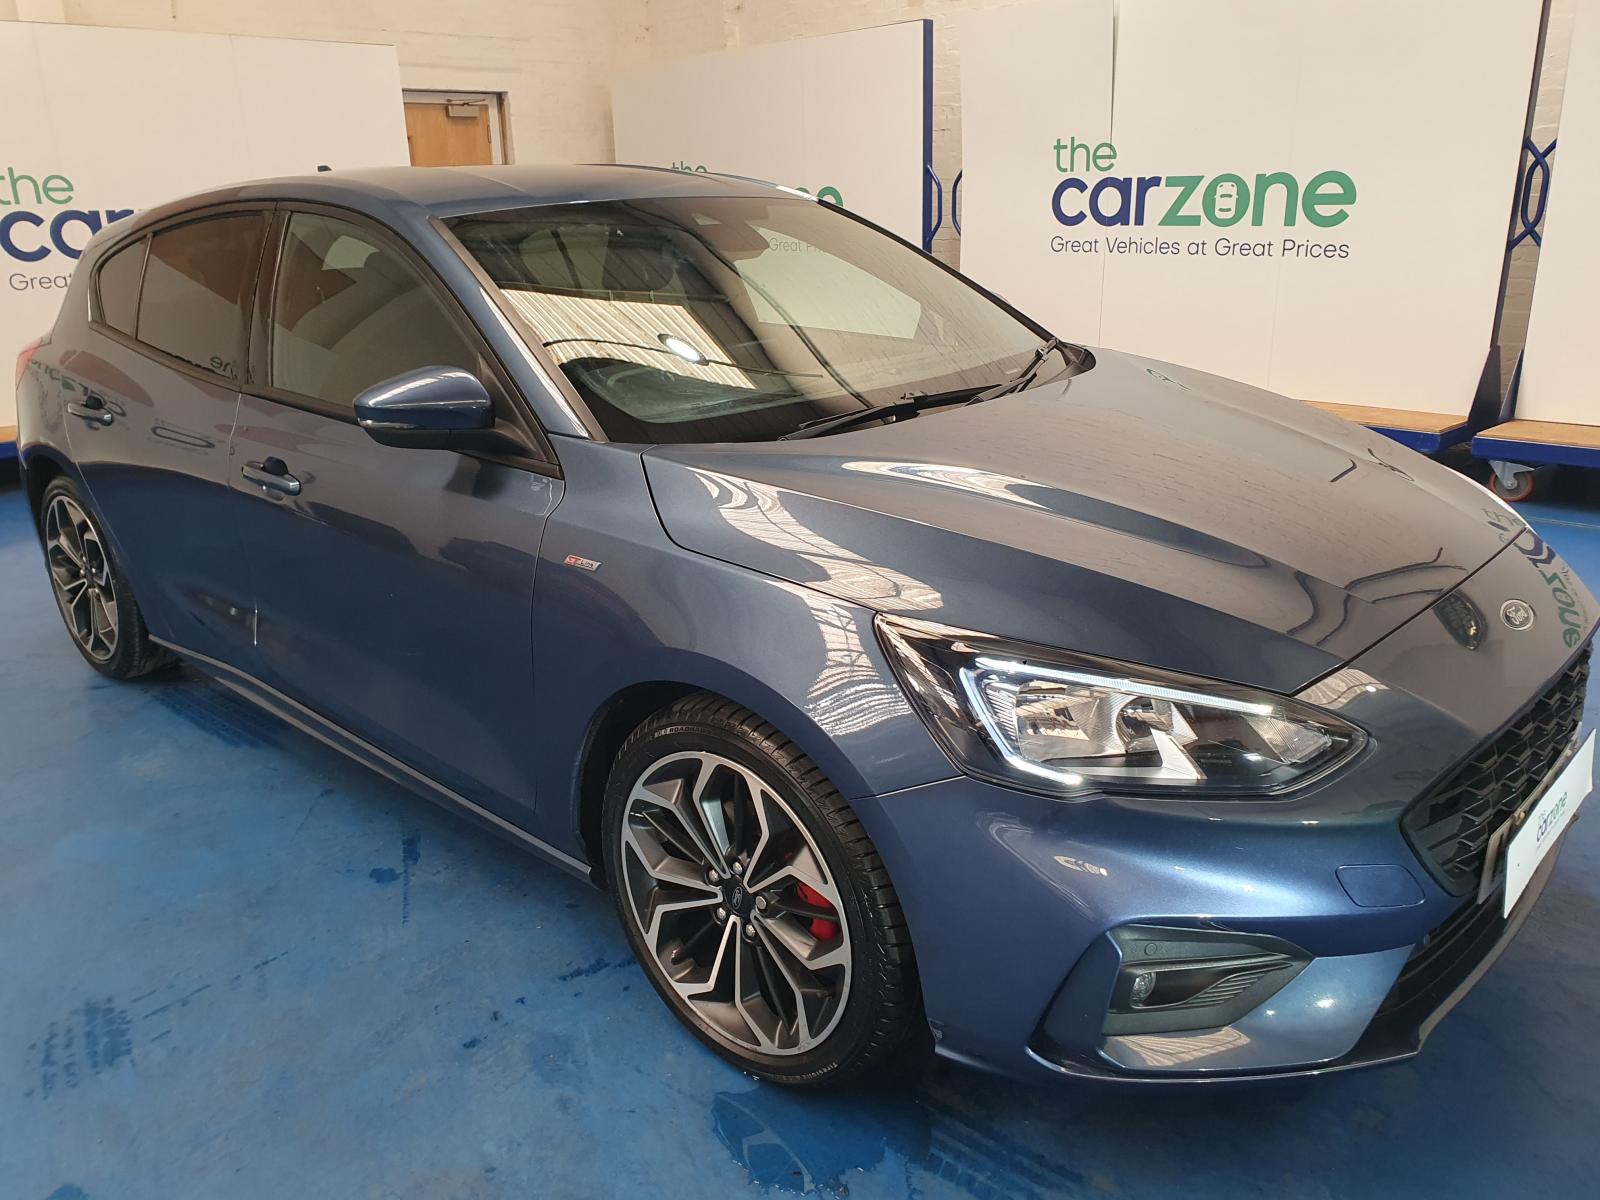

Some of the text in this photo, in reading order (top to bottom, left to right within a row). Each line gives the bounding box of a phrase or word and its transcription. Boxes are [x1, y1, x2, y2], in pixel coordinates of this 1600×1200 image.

[1053, 137, 1117, 173] the
[1052, 170, 1357, 227] carzone
[1050, 236, 1350, 258] Great Vehicles at Great Prices
[9, 273, 72, 291] Grea
